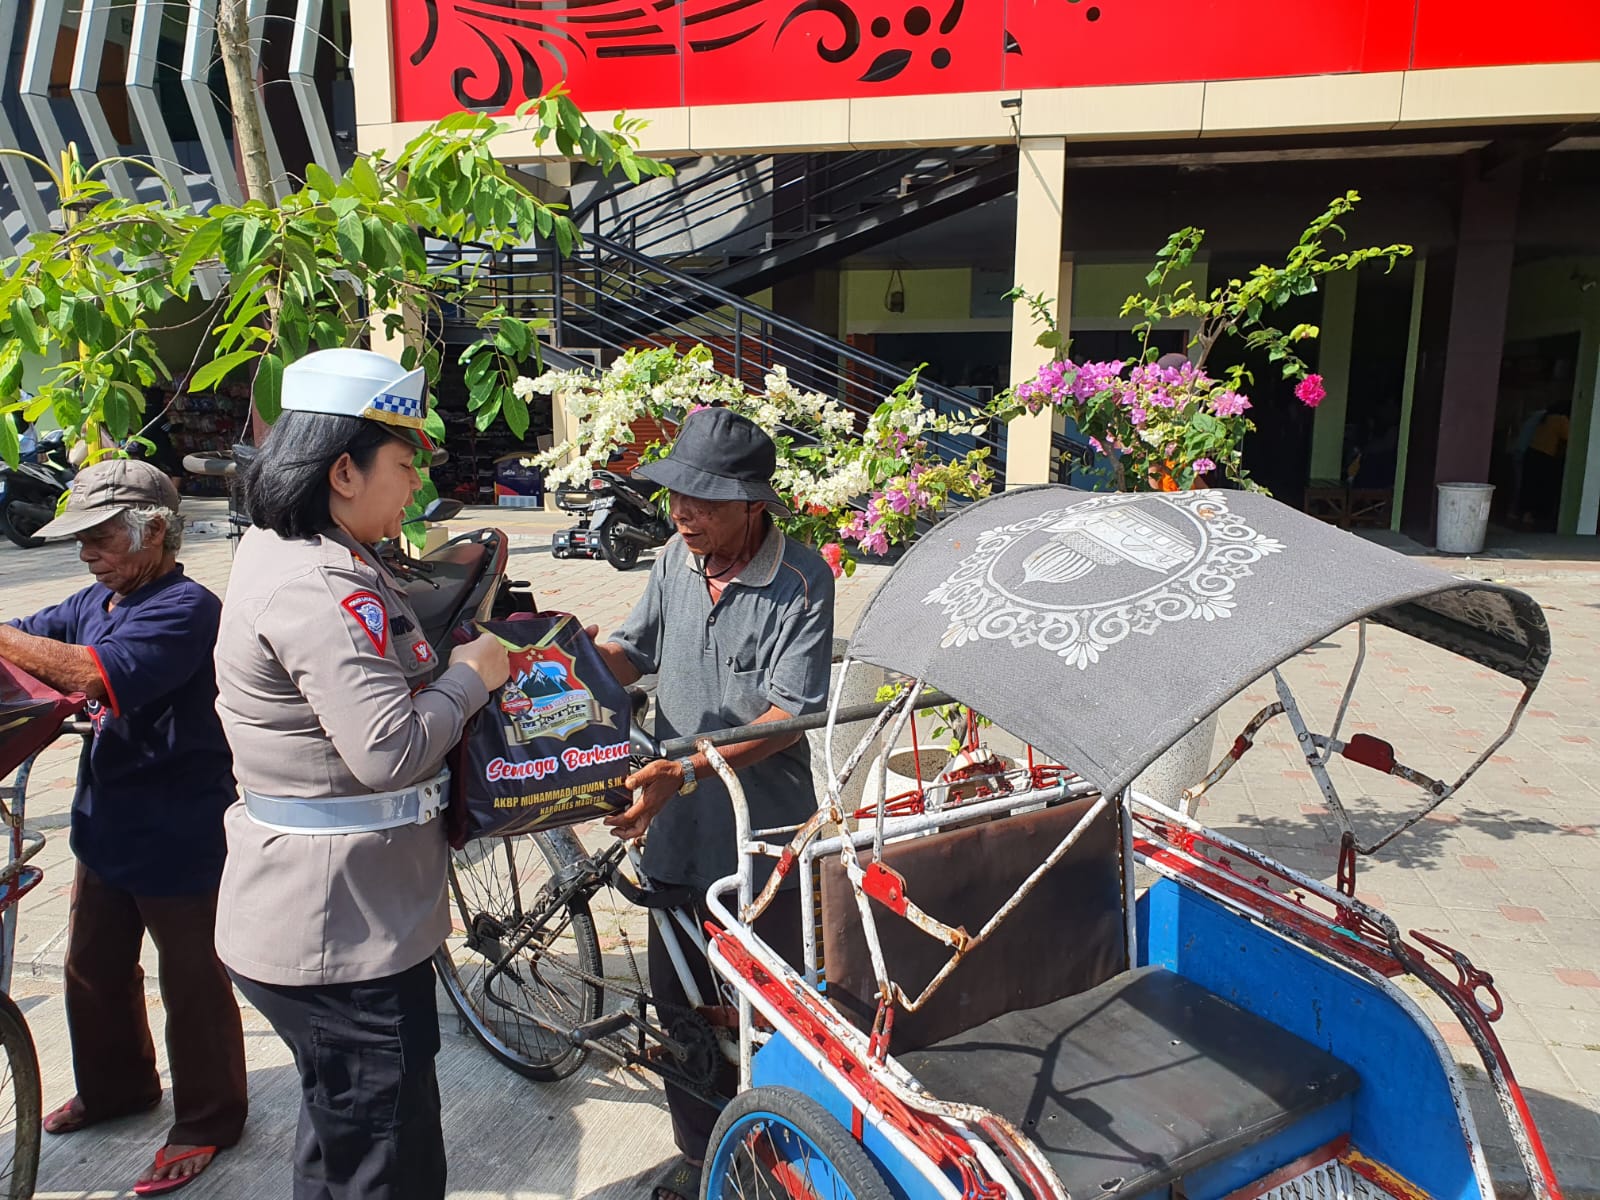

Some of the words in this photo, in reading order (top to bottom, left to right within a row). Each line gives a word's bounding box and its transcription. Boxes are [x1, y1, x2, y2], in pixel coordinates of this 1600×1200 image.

[486, 757, 559, 782] Semoga
[494, 797, 518, 808] AKBP
[521, 787, 571, 807] MUHAMMAD
